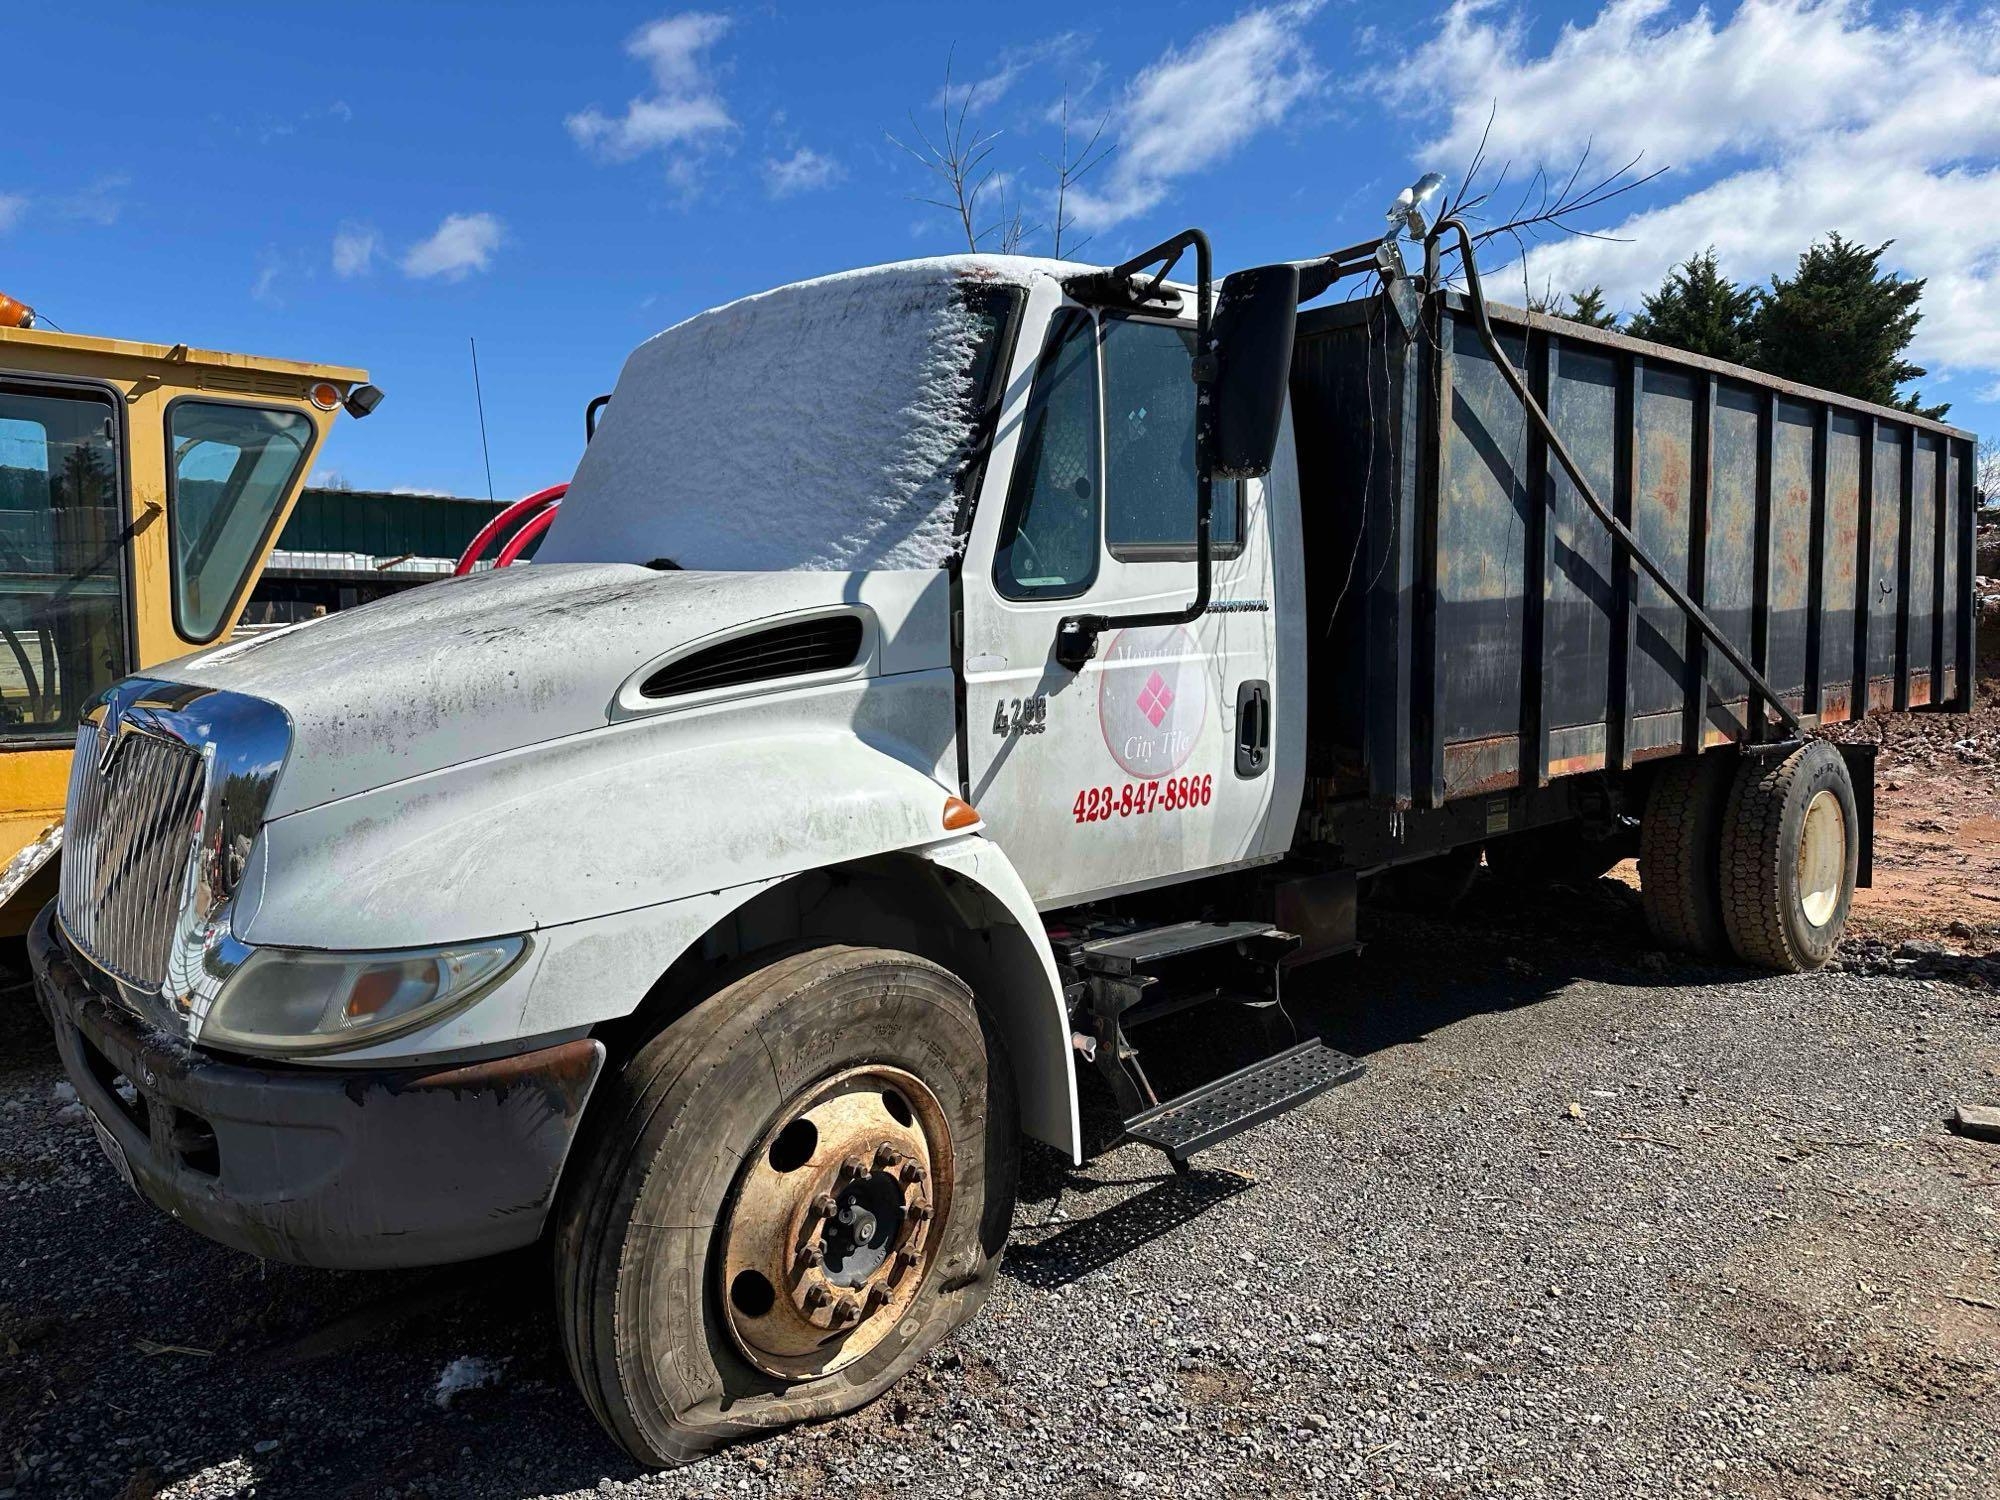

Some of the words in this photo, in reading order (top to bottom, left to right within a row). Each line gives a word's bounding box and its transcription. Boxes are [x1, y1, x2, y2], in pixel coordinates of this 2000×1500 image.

[992, 697, 1047, 738] 4200
[1124, 735, 1156, 763] City
[1161, 730, 1190, 755] Tile
[1072, 773, 1212, 824] 423-847-8866
